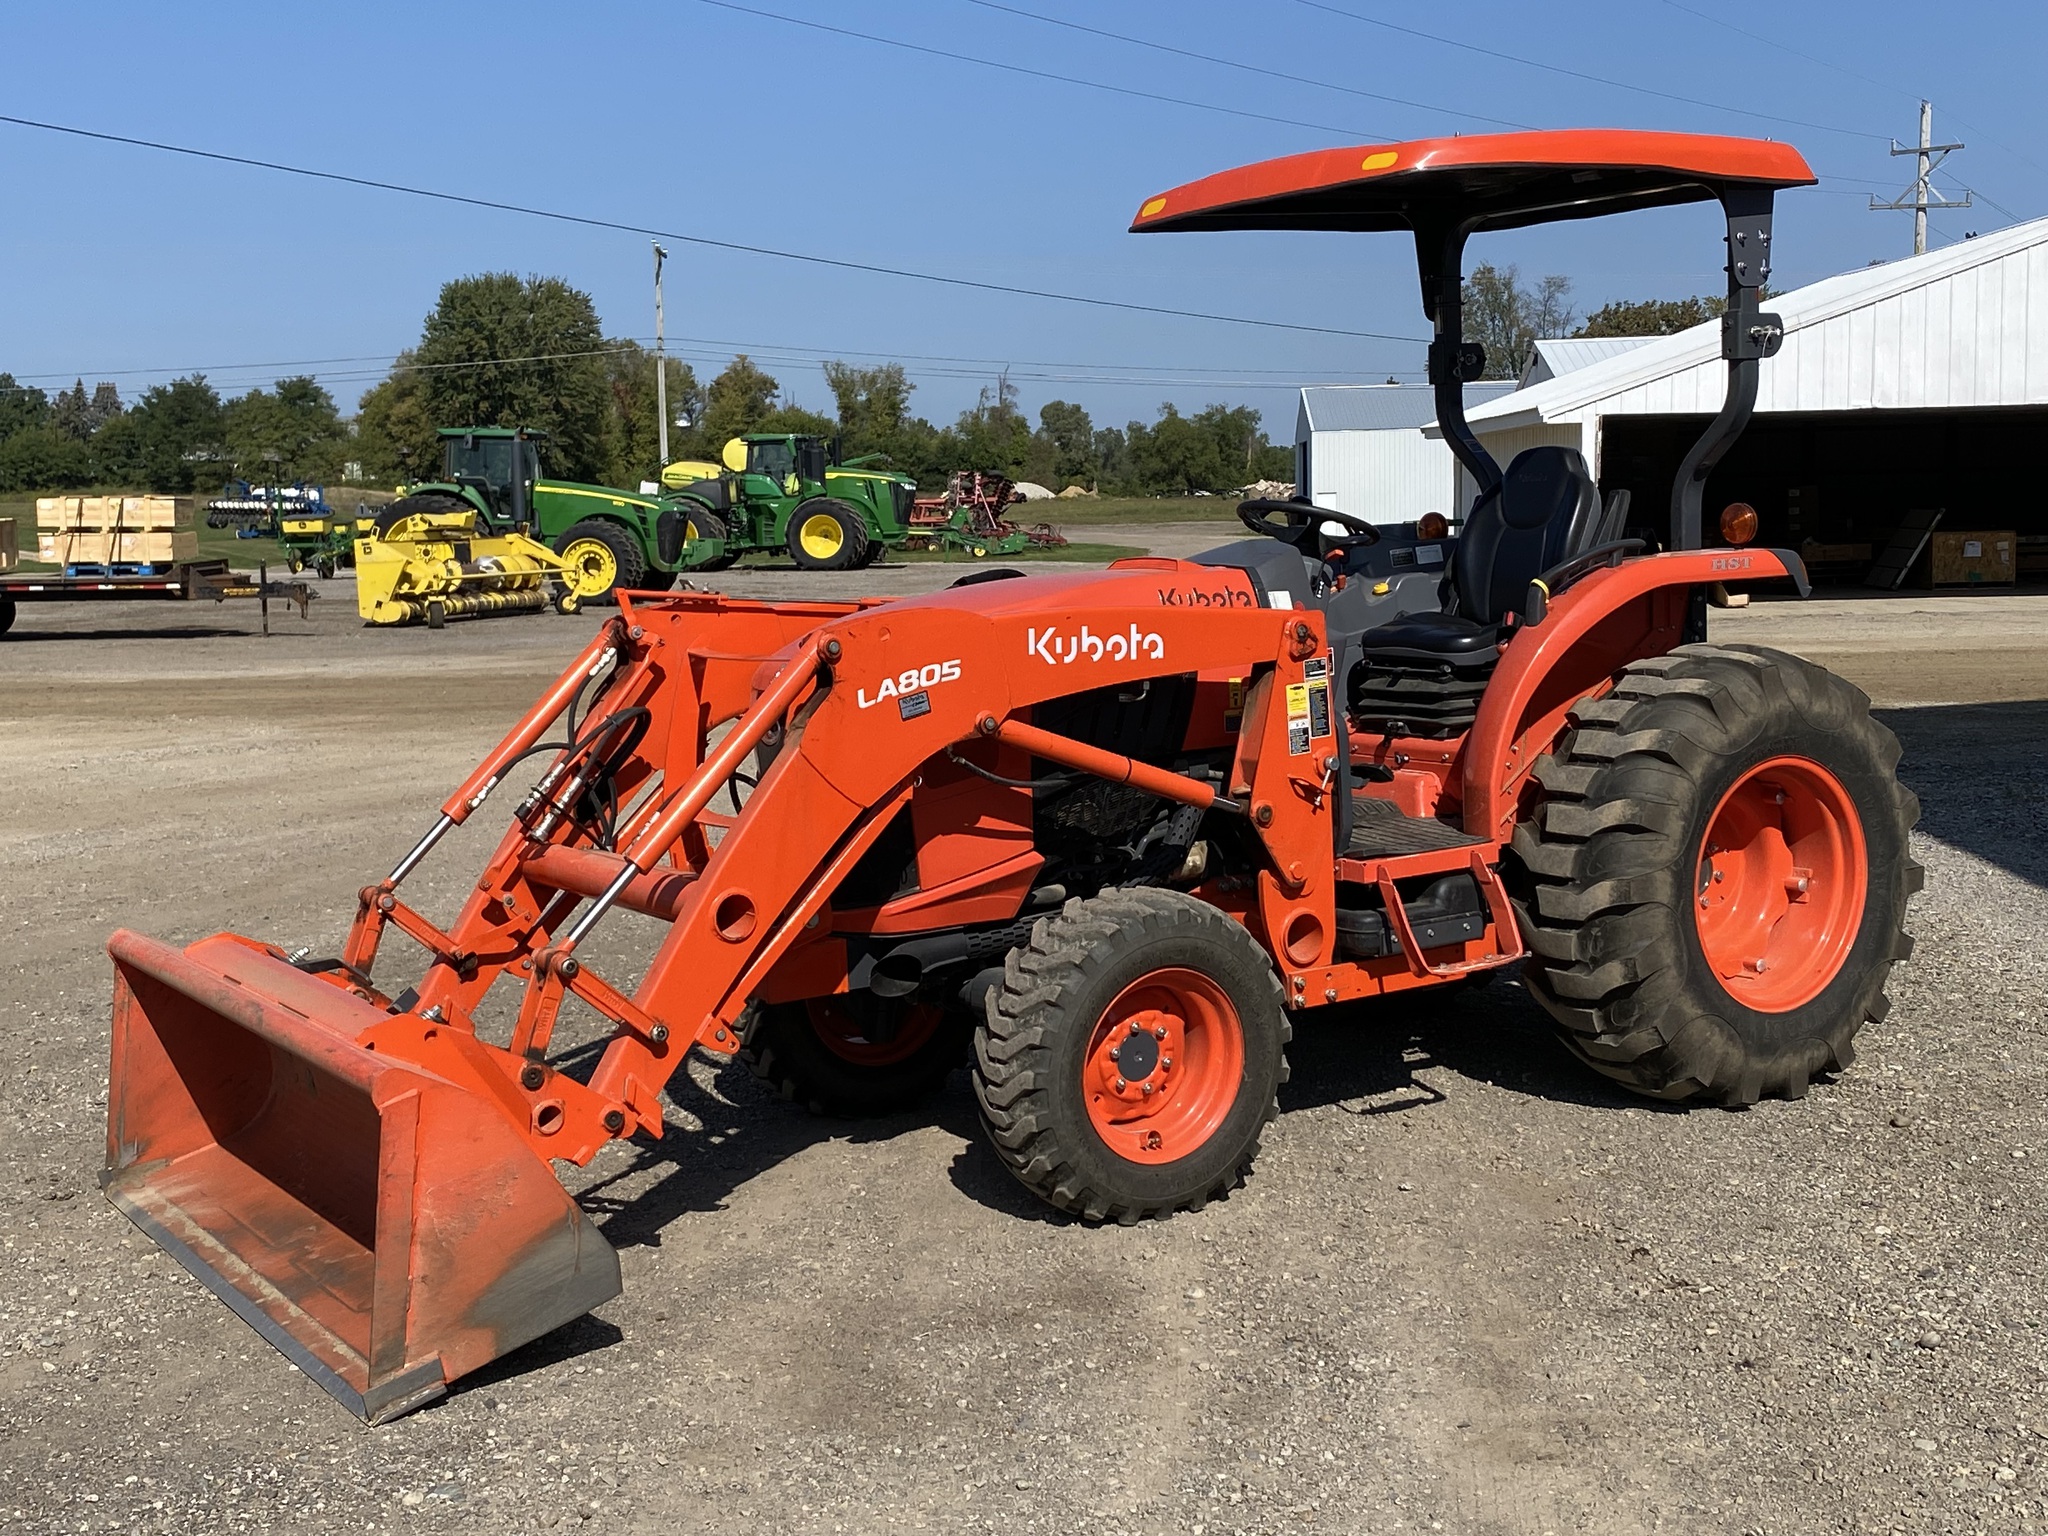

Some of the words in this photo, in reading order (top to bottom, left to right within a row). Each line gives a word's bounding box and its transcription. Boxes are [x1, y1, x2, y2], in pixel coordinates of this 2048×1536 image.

[1712, 557, 1754, 571] HST
[1158, 585, 1252, 608] Kubota
[1028, 623, 1164, 665] Kubota
[857, 659, 962, 709] LA805
